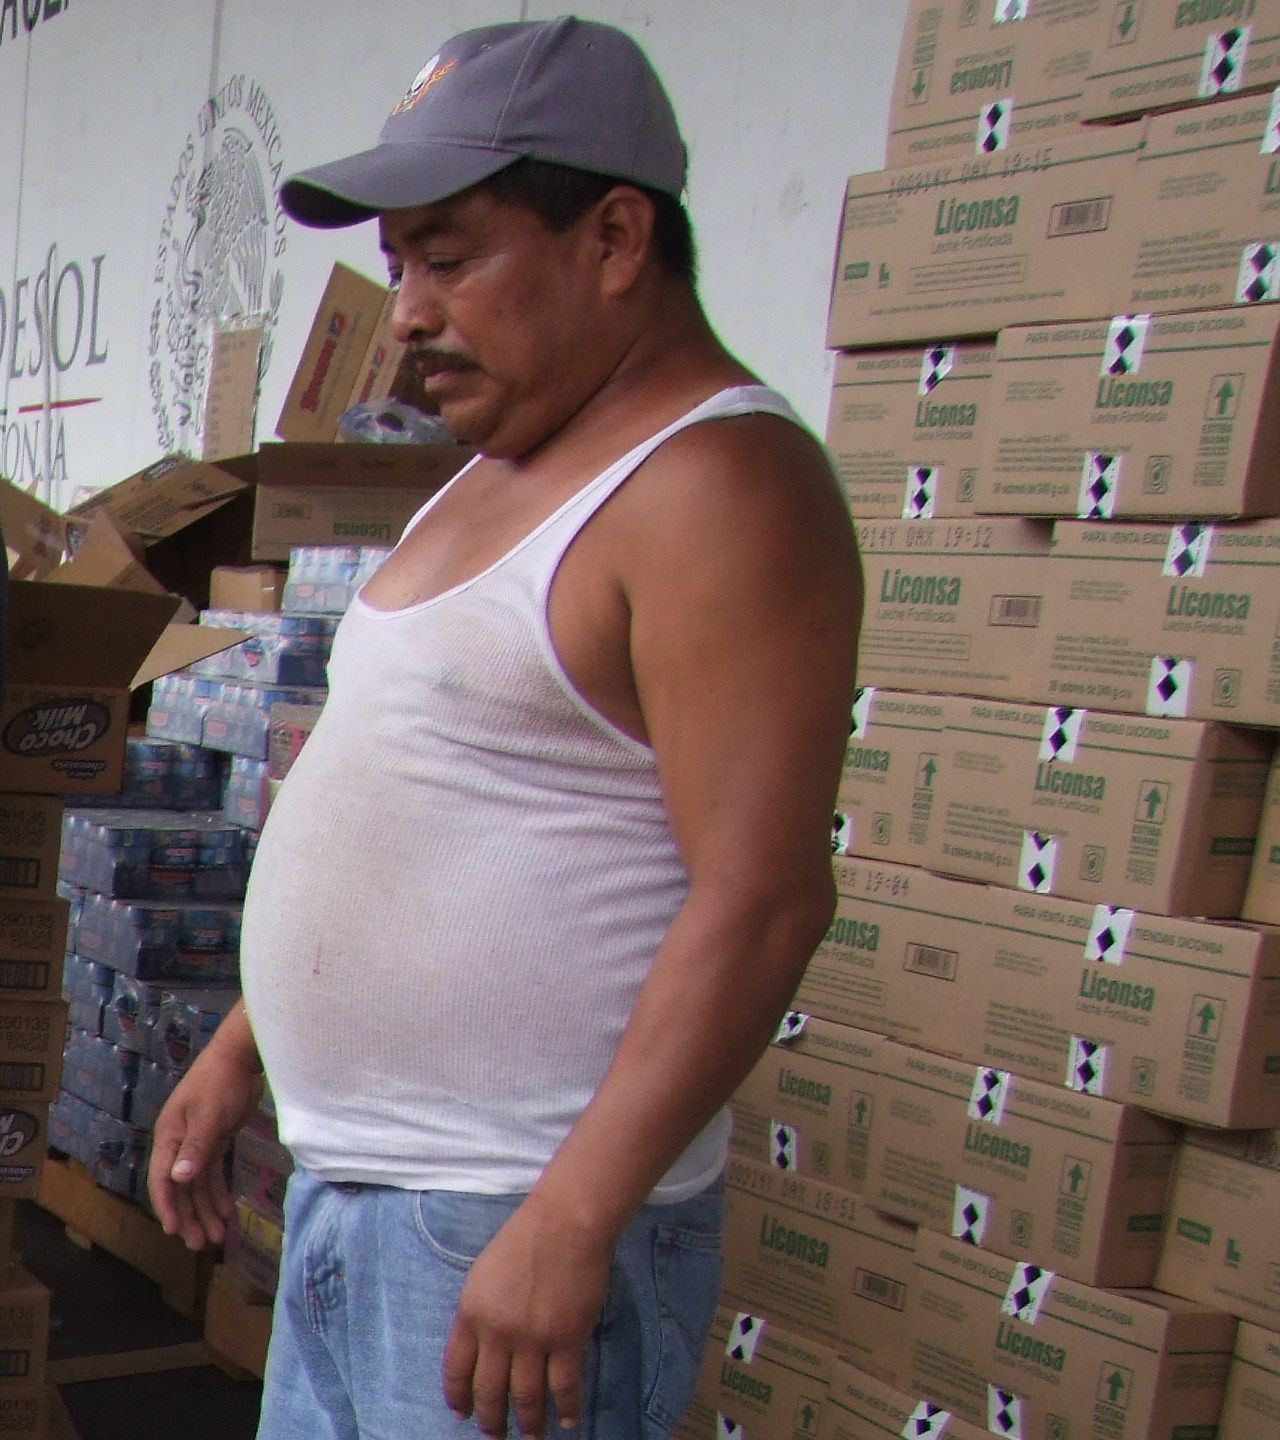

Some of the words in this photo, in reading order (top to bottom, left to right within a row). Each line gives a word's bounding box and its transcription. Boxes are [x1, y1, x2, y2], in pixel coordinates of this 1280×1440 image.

[934, 195, 1020, 237] Liconsa
[1094, 379, 1175, 409] Liconsa
[915, 400, 978, 428] Liconsa
[881, 568, 962, 606] Liconsa
[1168, 585, 1251, 620] Liconsa
[33, 704, 88, 731] Milk
[18, 723, 97, 751] Choco
[1034, 762, 1108, 799] Liconsa
[1079, 969, 1156, 1012] Liconsa
[778, 1068, 832, 1105] Liconsa
[965, 1125, 1032, 1168] Liconsa
[761, 1214, 830, 1269] Liconsa
[996, 1322, 1067, 1371] Liconsa
